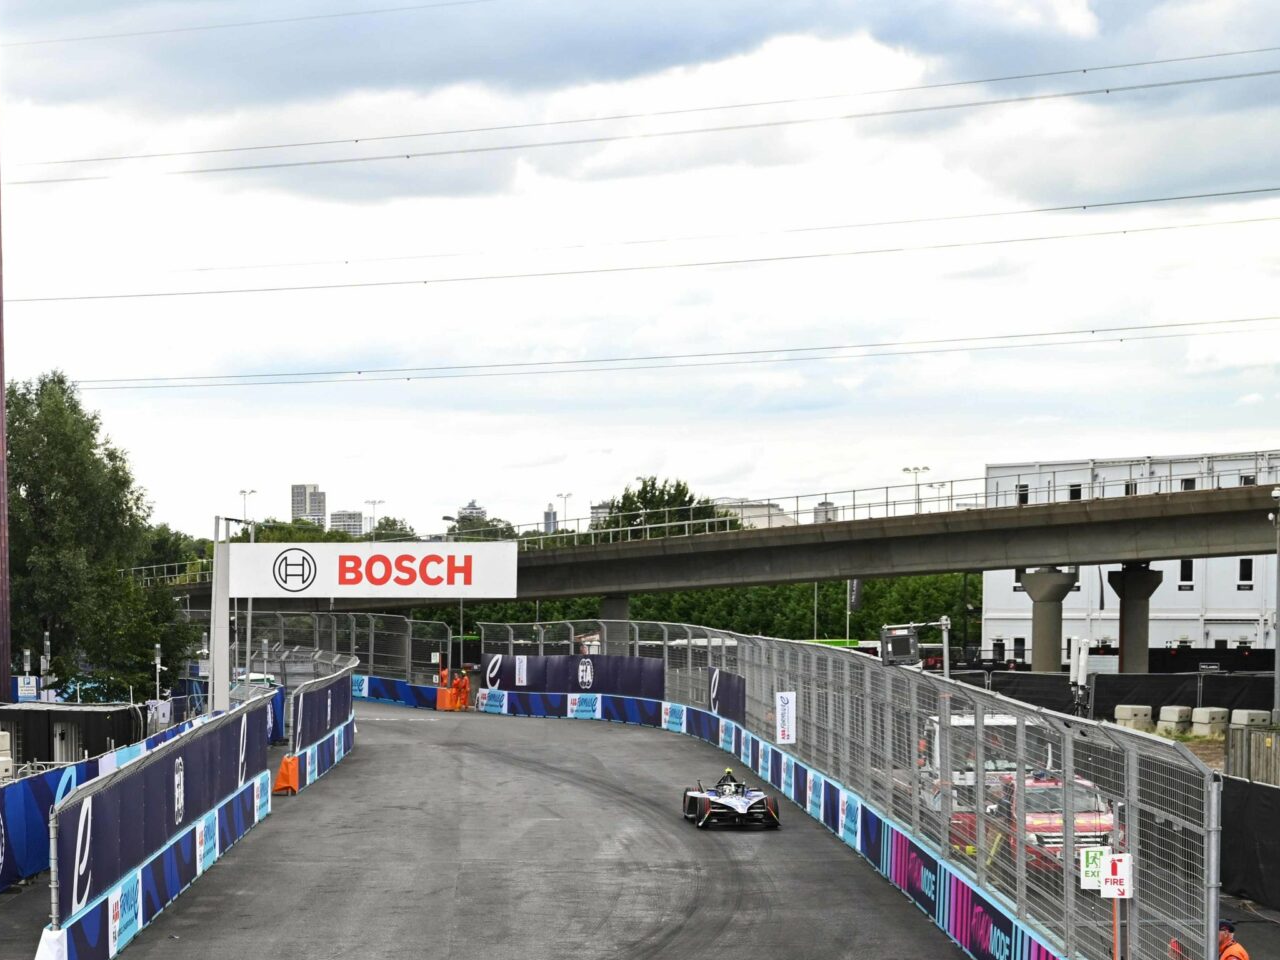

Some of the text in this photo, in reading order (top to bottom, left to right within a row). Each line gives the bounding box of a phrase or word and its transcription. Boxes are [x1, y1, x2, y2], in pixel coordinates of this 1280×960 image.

[338, 554, 473, 586] BOSCH
[1084, 870, 1100, 878] EXI
[1104, 878, 1125, 886] FIRE
